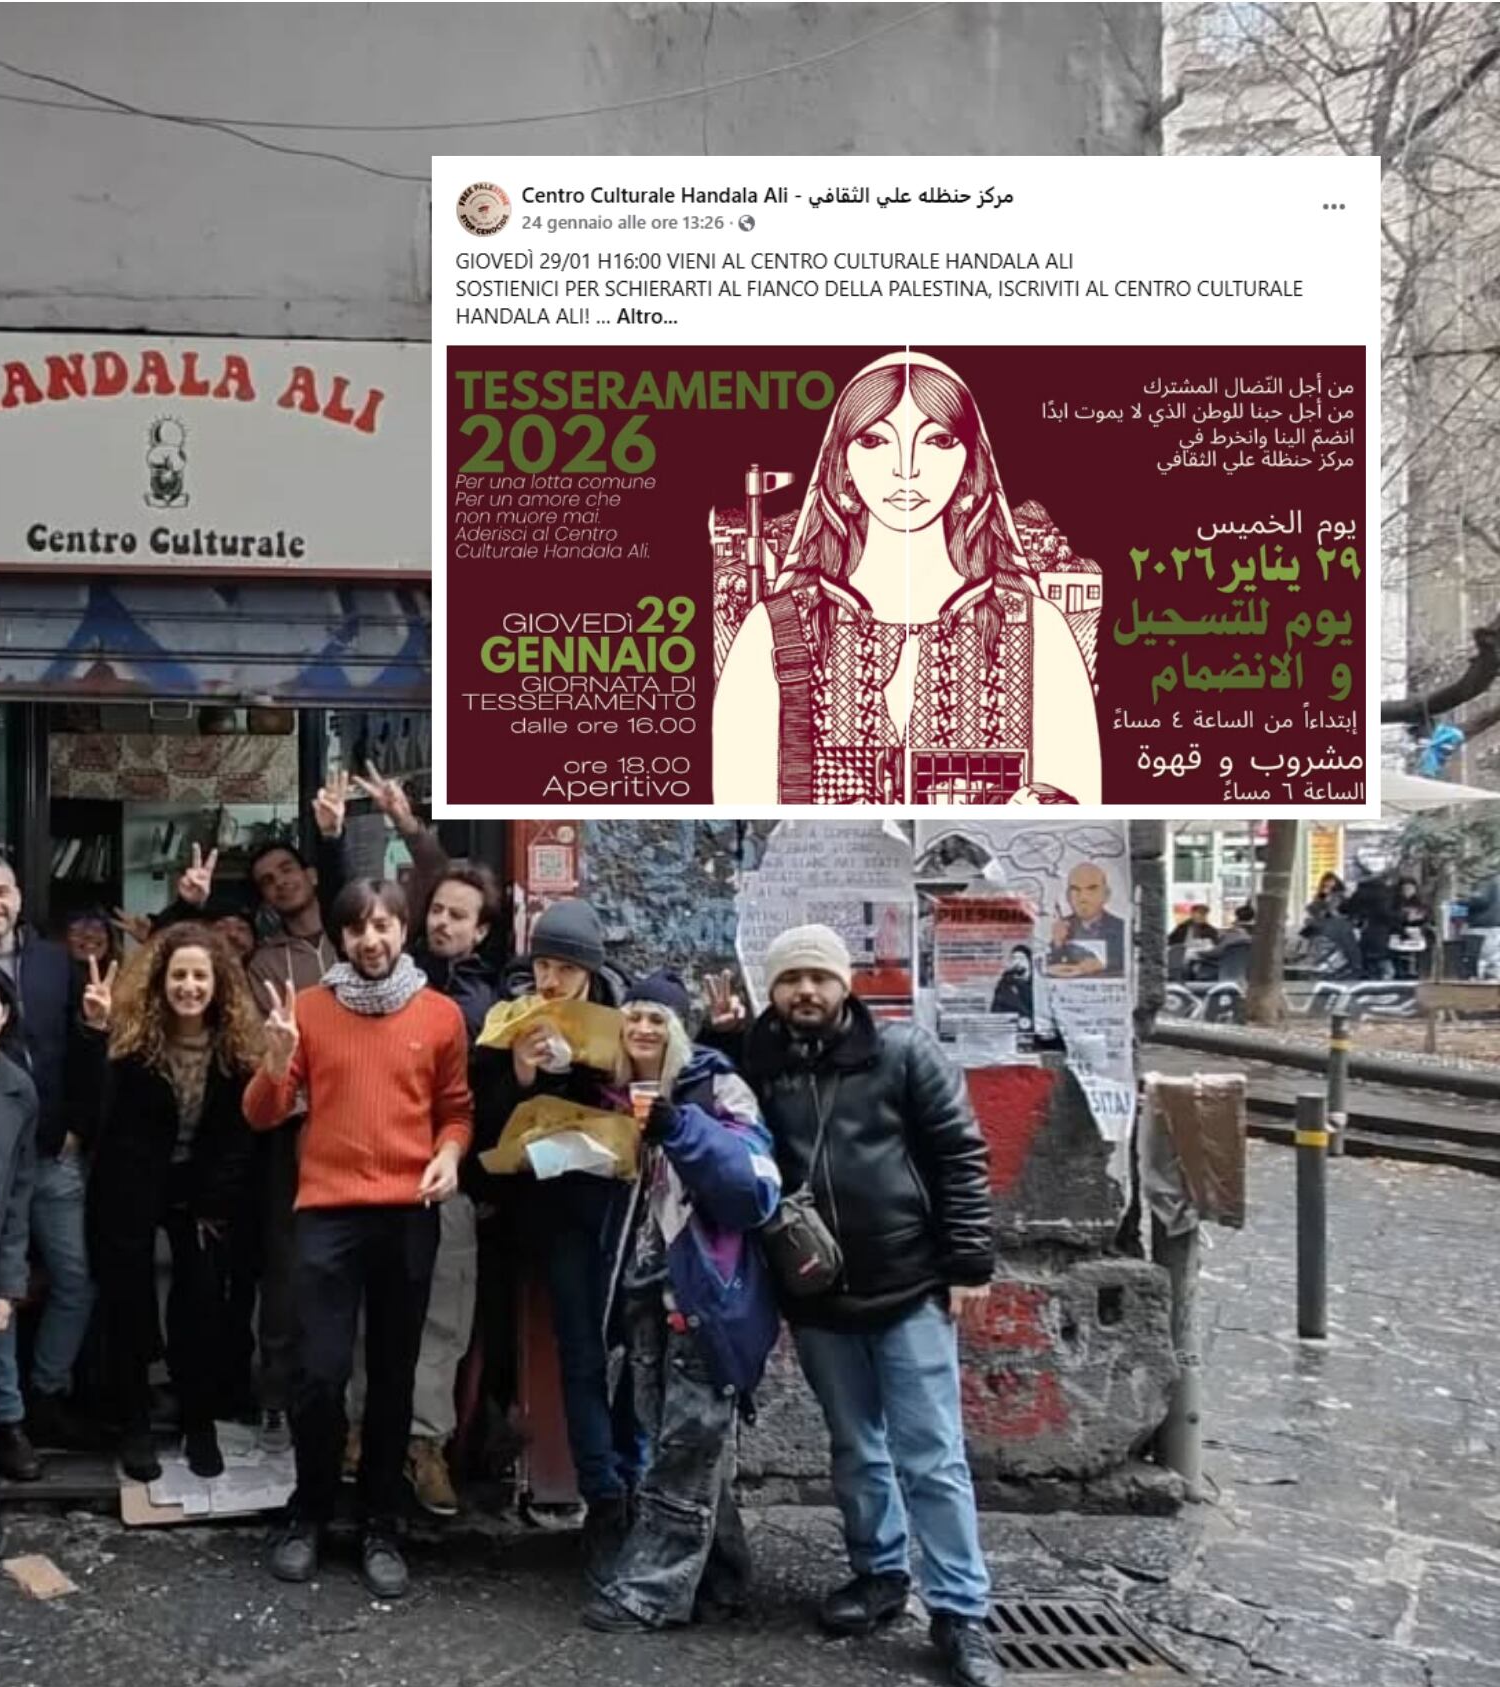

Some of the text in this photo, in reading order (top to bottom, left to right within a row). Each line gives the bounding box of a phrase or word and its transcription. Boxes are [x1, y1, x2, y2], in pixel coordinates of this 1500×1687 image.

[277, 365, 386, 434] ALI
[27, 524, 306, 560] Centro Culturale
